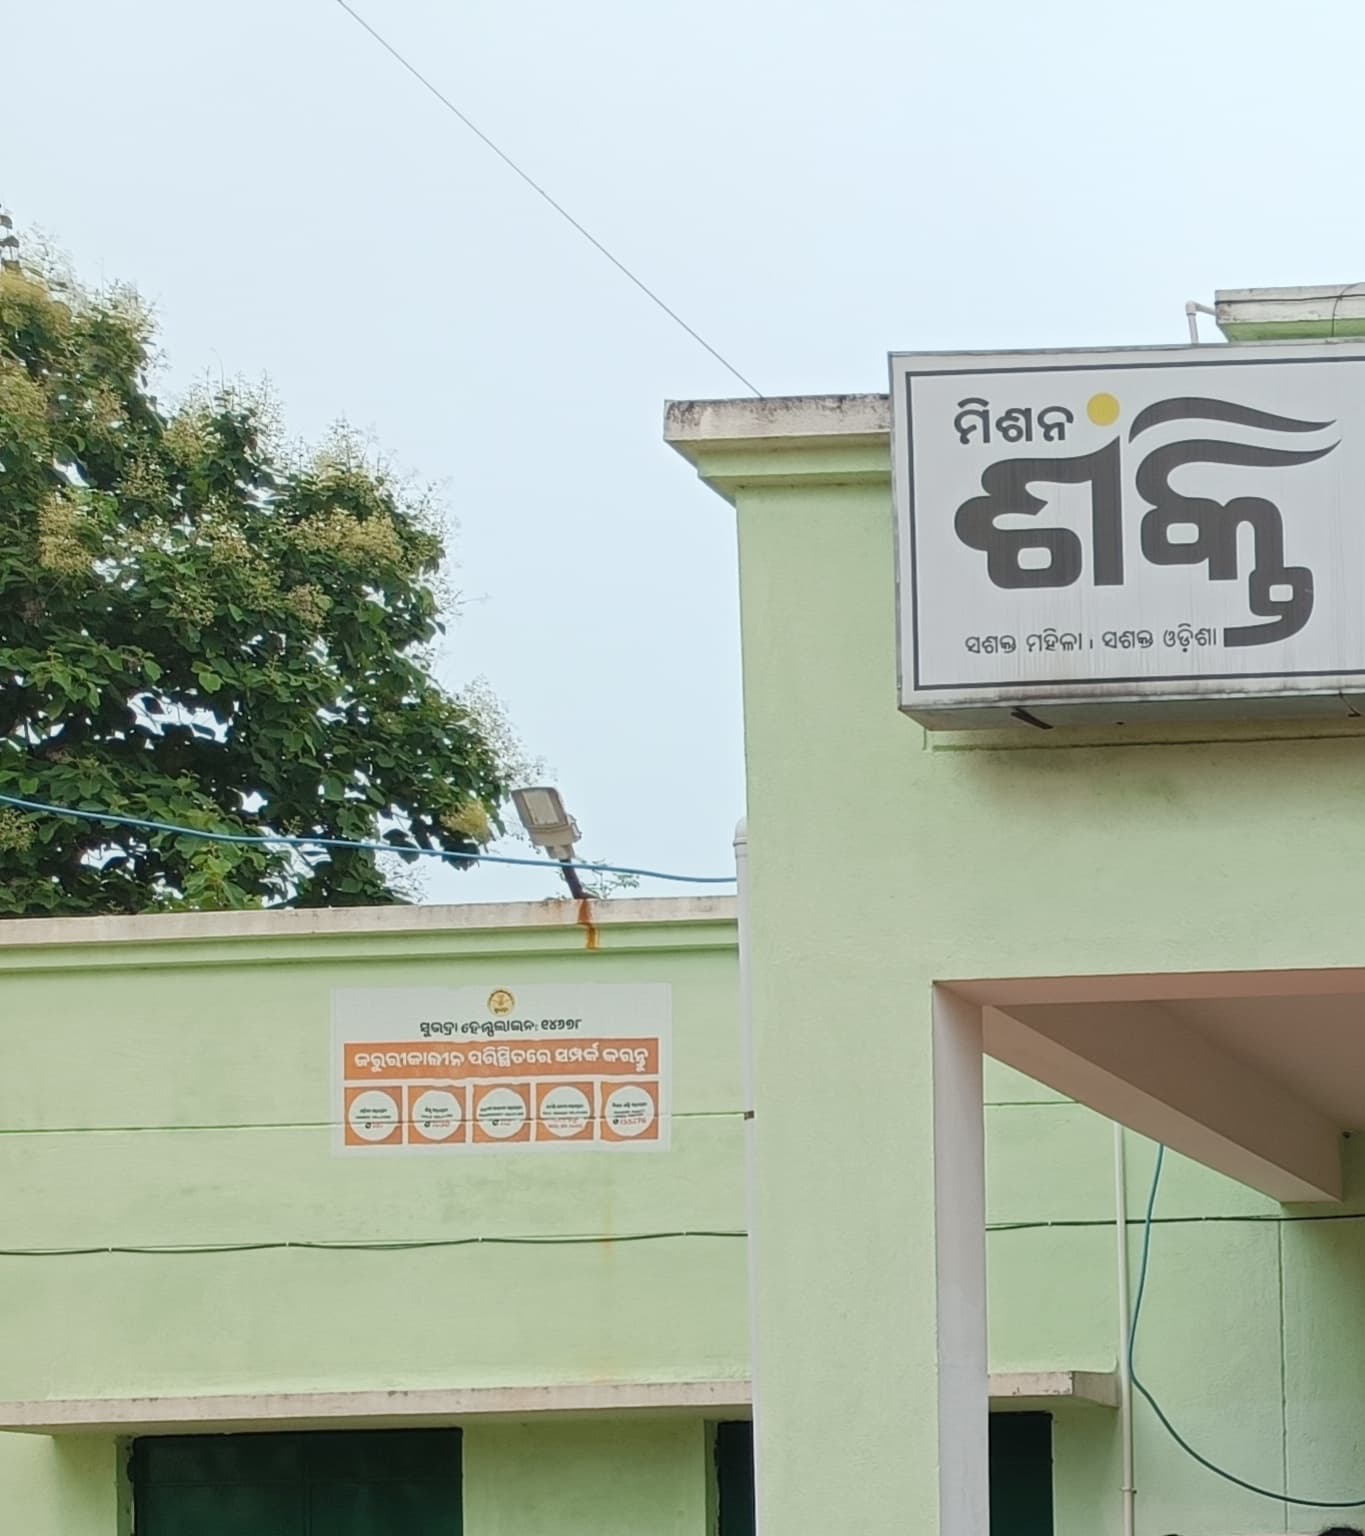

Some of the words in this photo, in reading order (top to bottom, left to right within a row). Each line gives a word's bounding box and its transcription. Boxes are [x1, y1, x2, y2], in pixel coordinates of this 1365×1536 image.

[953, 397, 1074, 444] ମିଶନ
[965, 634, 1017, 654] ସଶକ୍ତ
[1026, 628, 1083, 652] ମହିଳା
[1101, 629, 1154, 649] ସଶକ୍ତ
[1163, 623, 1217, 653] ଓଡ଼ିଶା
